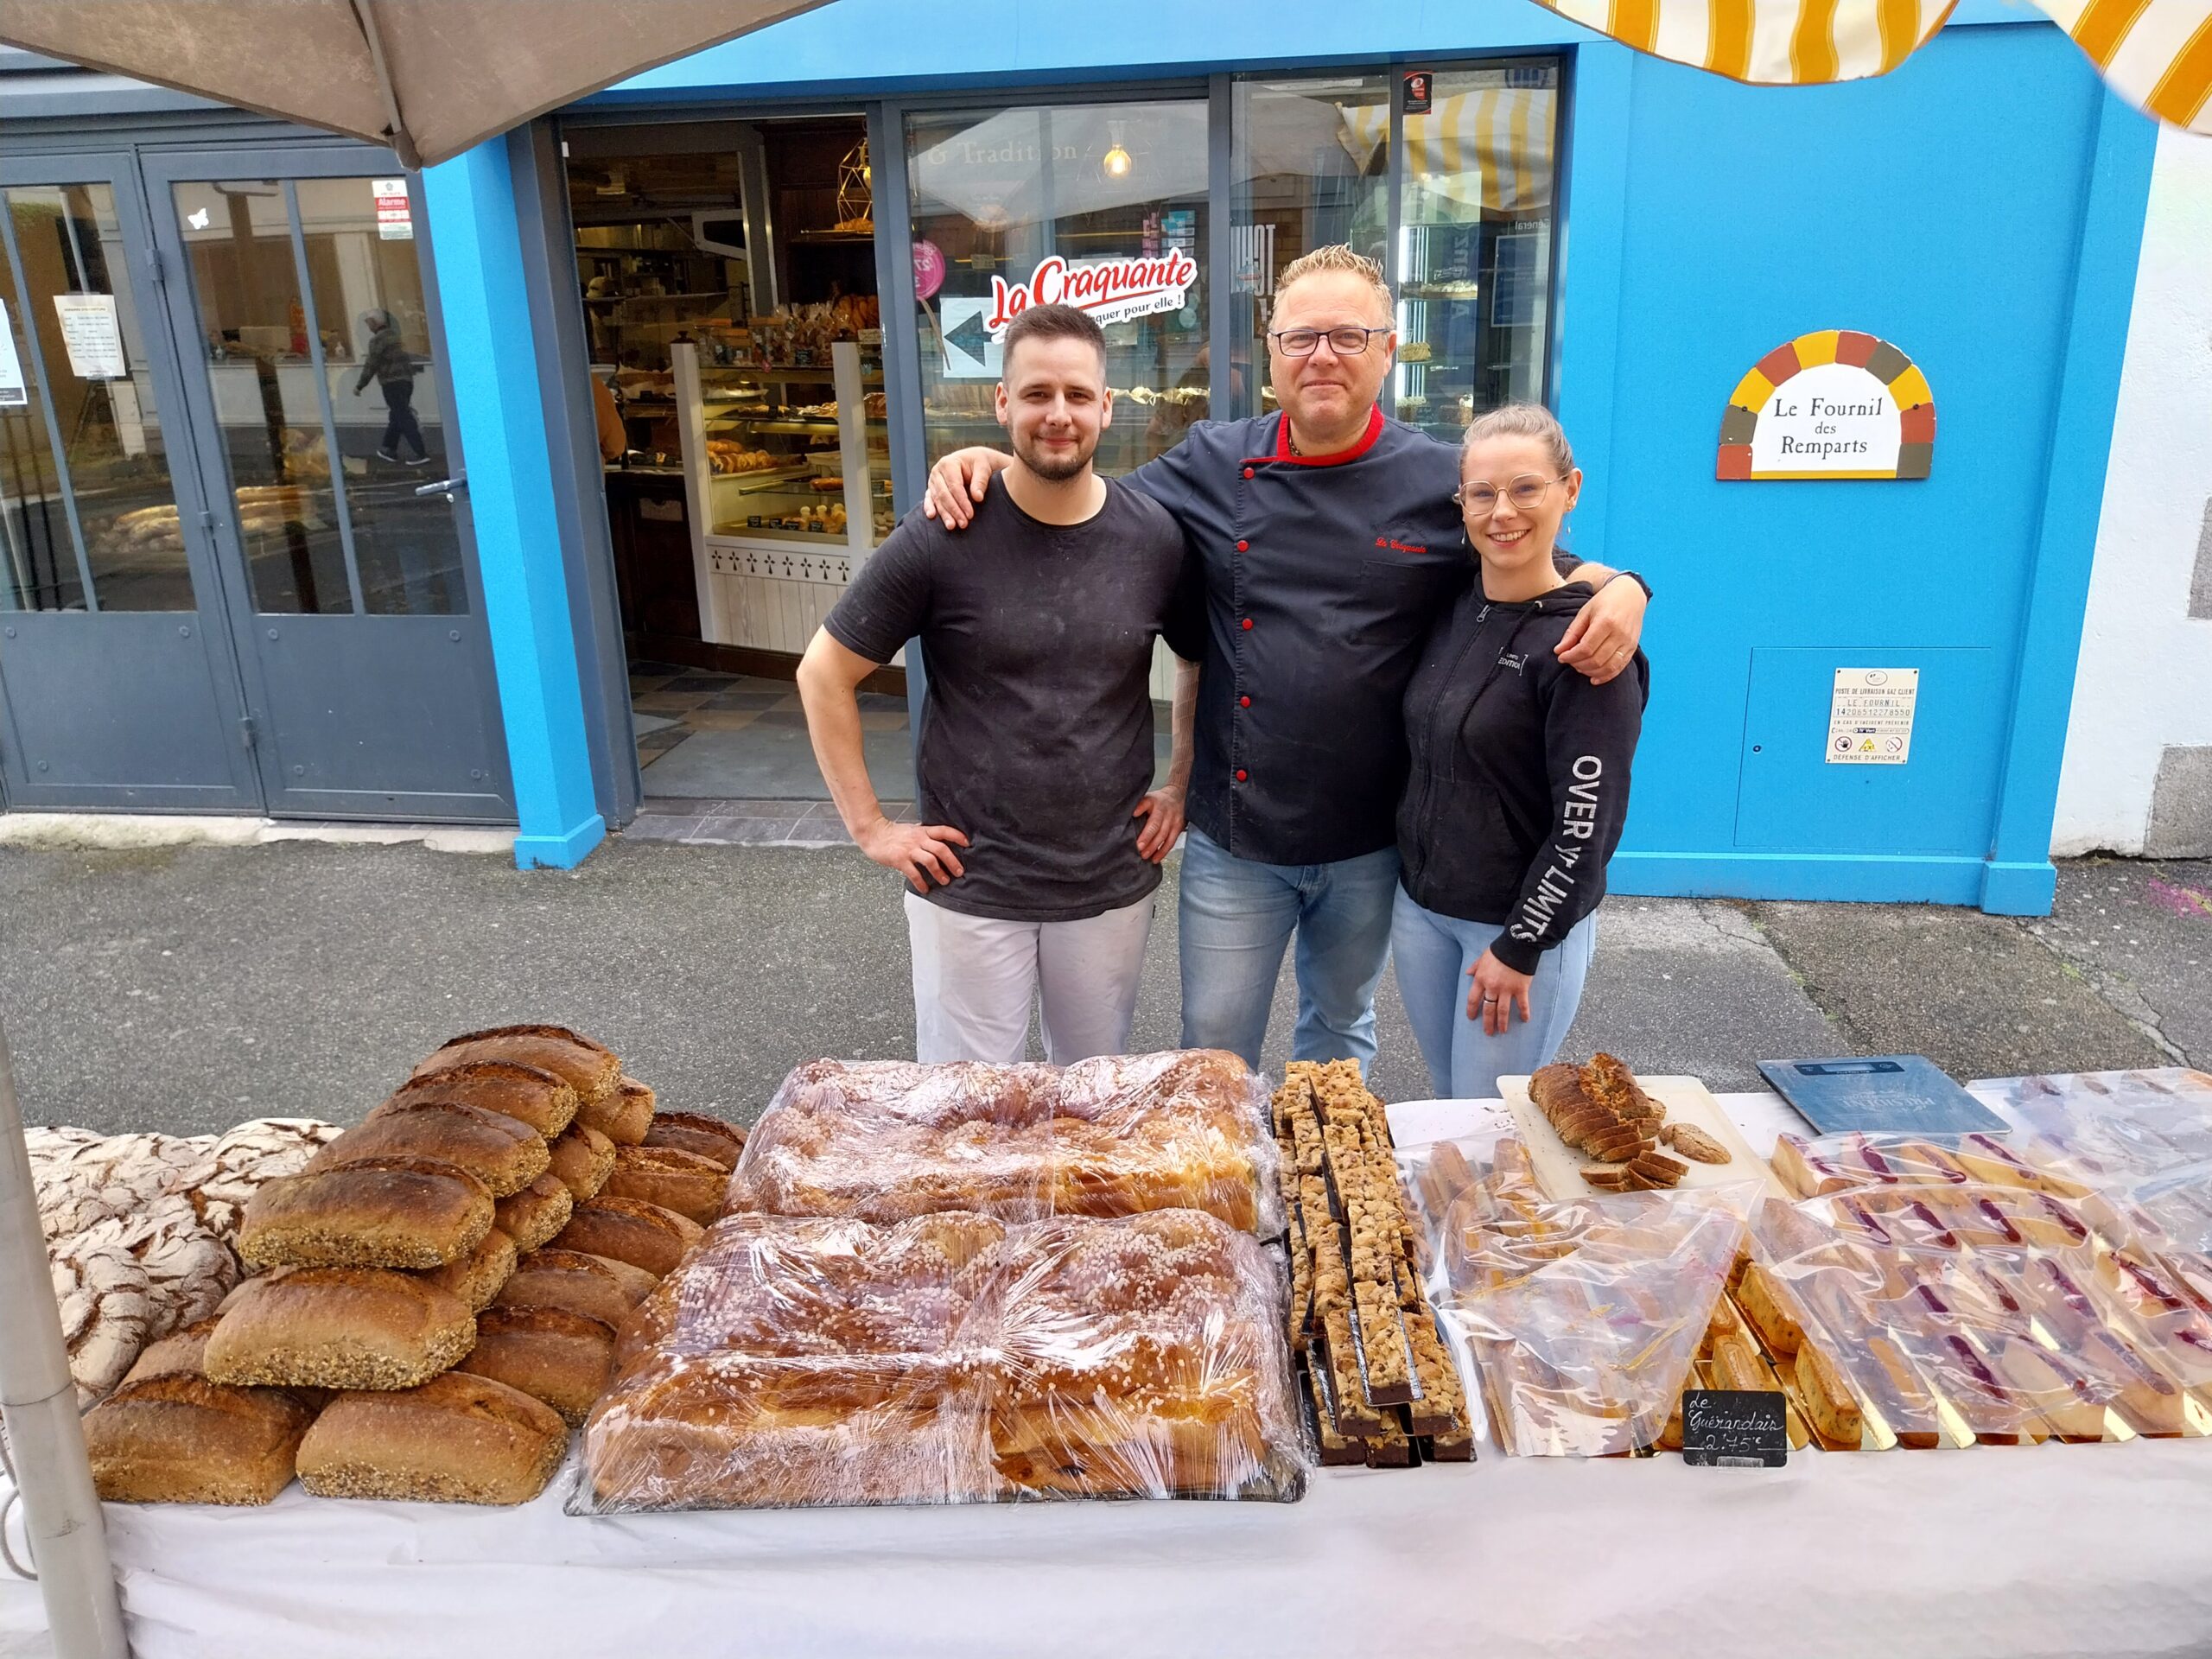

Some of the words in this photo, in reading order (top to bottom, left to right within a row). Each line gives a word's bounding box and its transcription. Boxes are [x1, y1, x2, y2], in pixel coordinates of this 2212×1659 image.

[957, 141, 1077, 164] Traditon
[988, 279, 1027, 329] La
[1033, 251, 1193, 306] Craquante
[1095, 310, 1121, 324] quer
[1123, 302, 1151, 318] pour
[1154, 296, 1173, 309] elle
[1774, 398, 1798, 417] Le
[1810, 397, 1883, 417] Fournil
[1815, 422, 1837, 435] des
[1781, 436, 1868, 460] Remparts
[1562, 754, 1602, 840] OVER
[1509, 864, 1575, 944] LIMITS
[1689, 1392, 1712, 1408] Le
[1688, 1410, 1784, 1432] Guérandais
